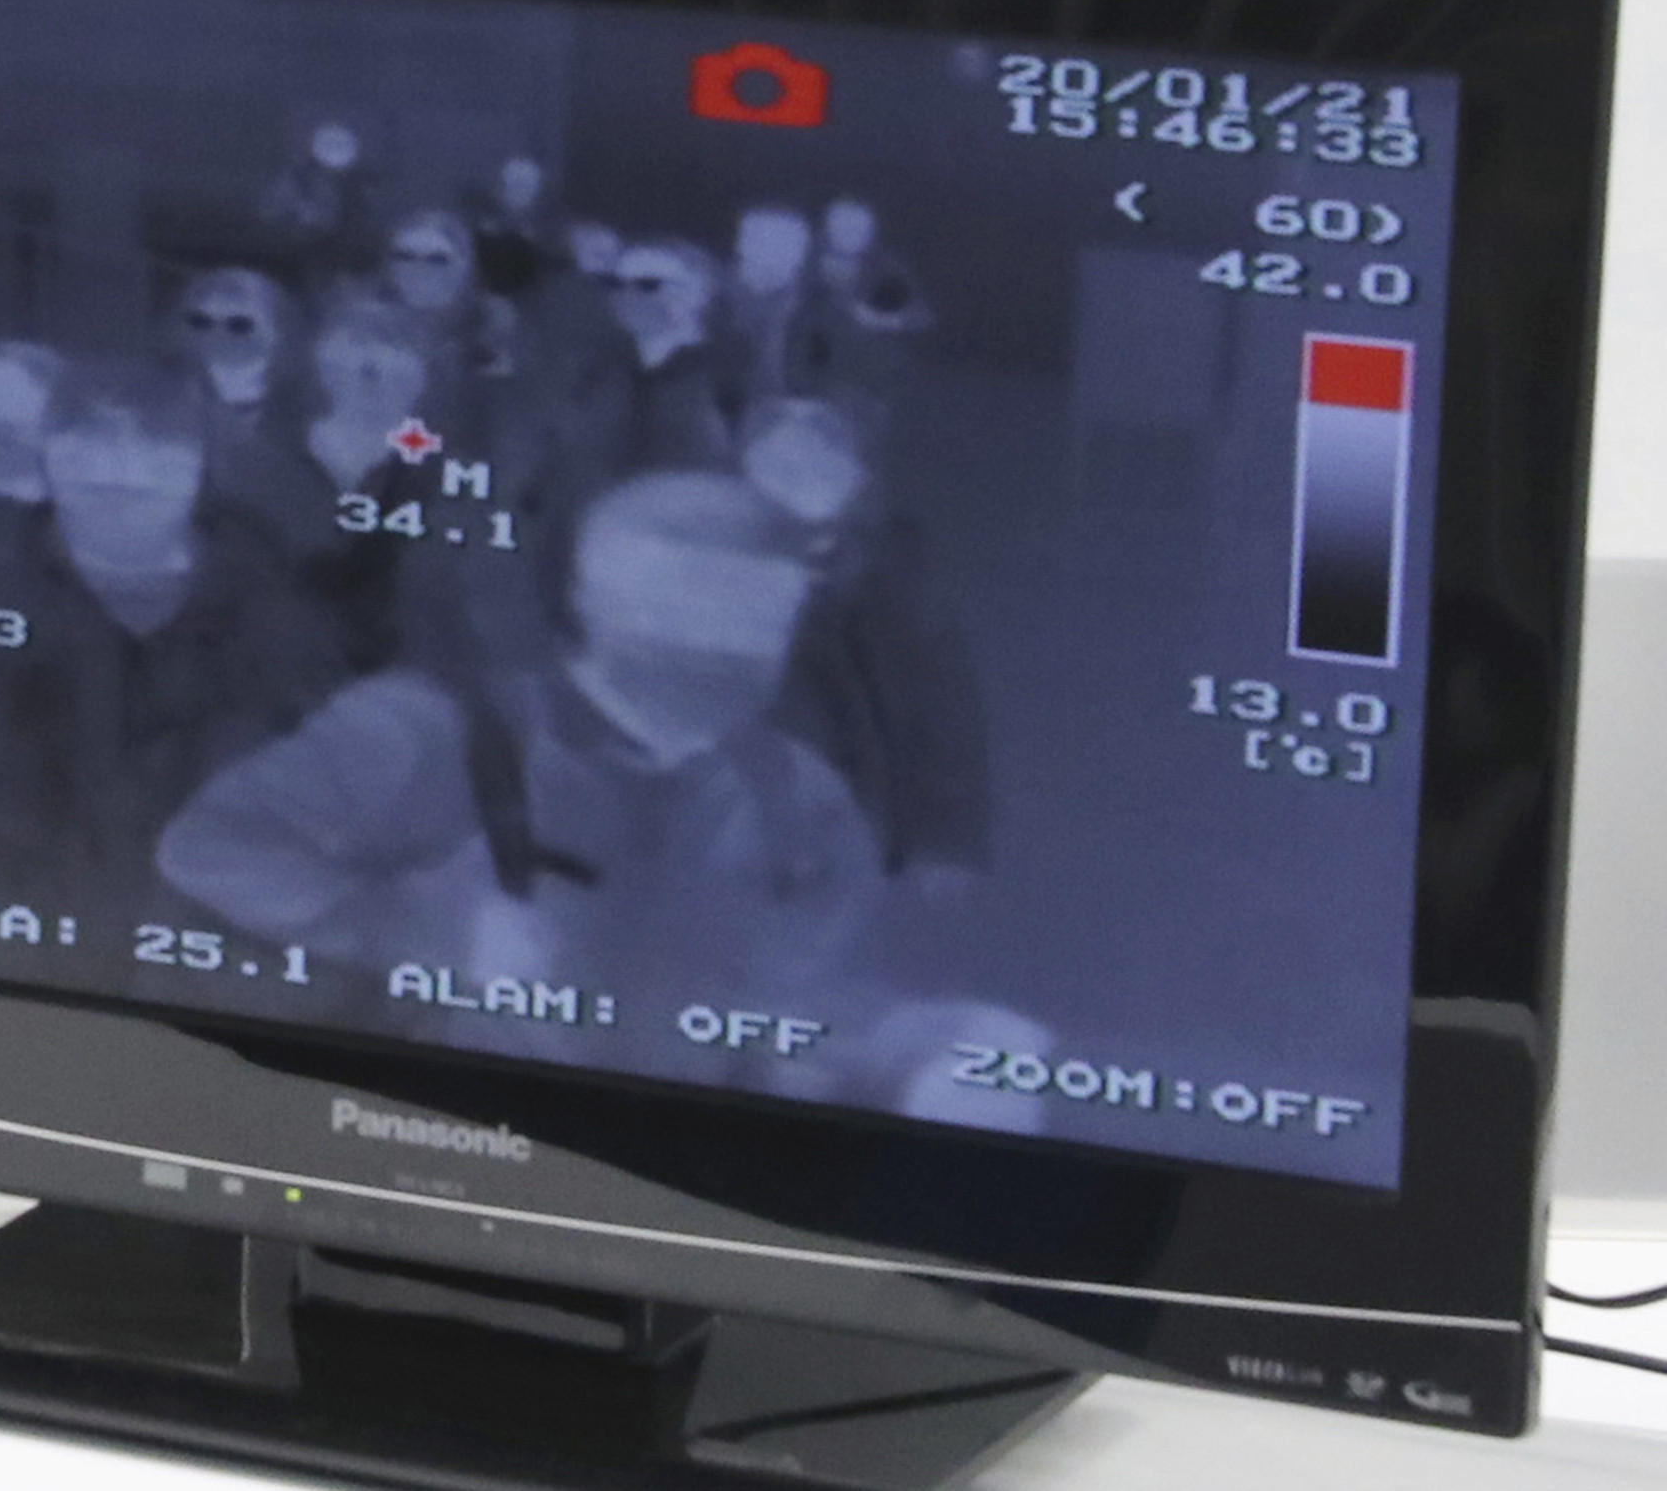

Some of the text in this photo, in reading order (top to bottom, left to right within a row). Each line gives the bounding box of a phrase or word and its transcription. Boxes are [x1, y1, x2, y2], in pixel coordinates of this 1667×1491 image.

[998, 55, 1412, 126] 20/01/21
[1010, 97, 1419, 167] 15:46:33
[1200, 251, 1411, 305] 42.0
[442, 459, 490, 499] M
[336, 492, 516, 550] 34.1
[1189, 674, 1387, 735] 13.0
[133, 923, 309, 983] 25.1
[389, 962, 615, 1024] ALAM:
[677, 1004, 822, 1054] OFF
[331, 1097, 533, 1163] Panasonic
